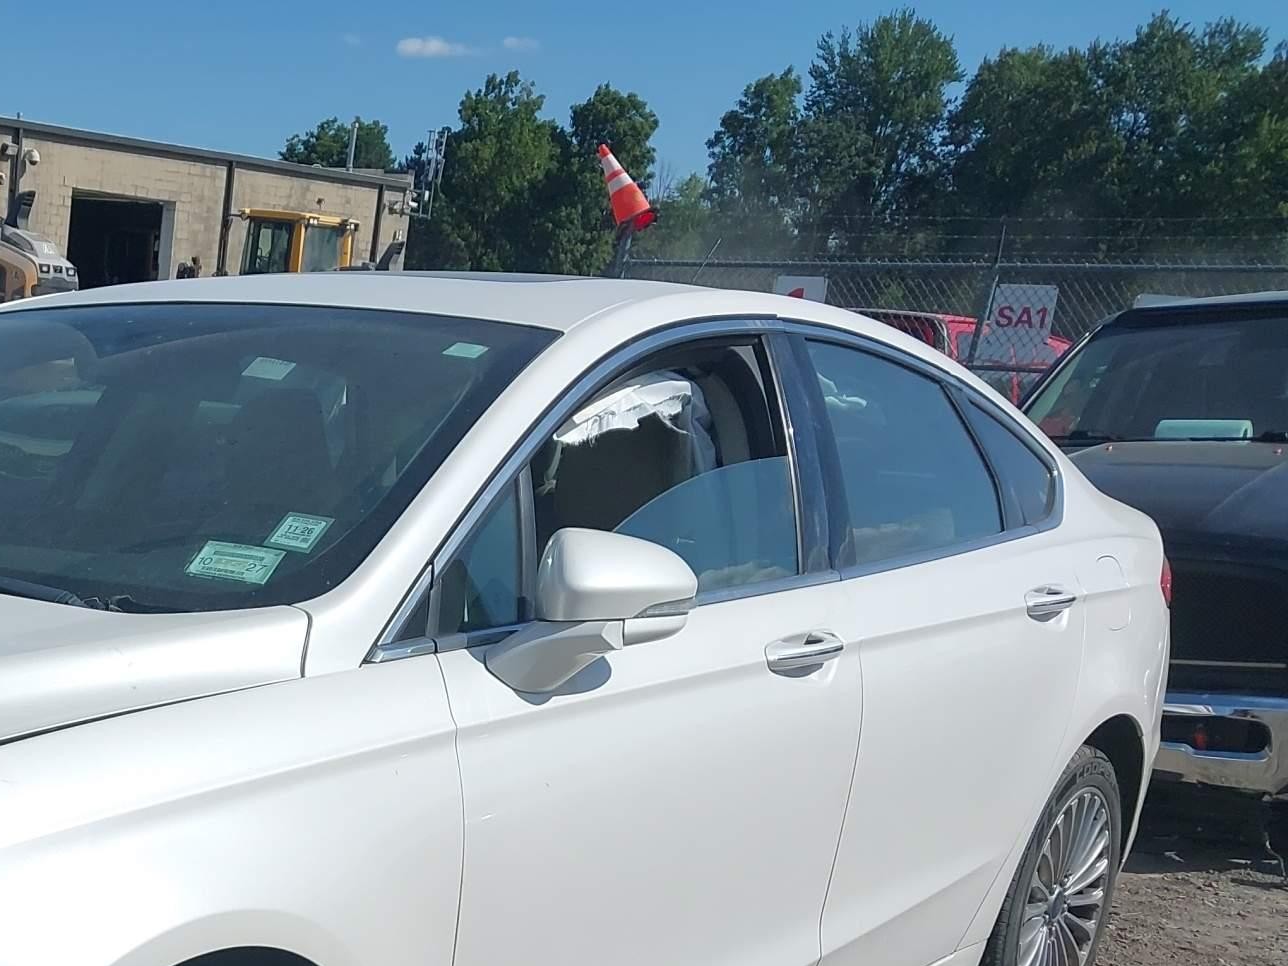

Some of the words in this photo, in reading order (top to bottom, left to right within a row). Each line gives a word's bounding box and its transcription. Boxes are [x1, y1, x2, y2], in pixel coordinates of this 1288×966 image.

[995, 305, 1049, 329] SA1
[198, 557, 214, 566] 10
[245, 562, 269, 573] 27
